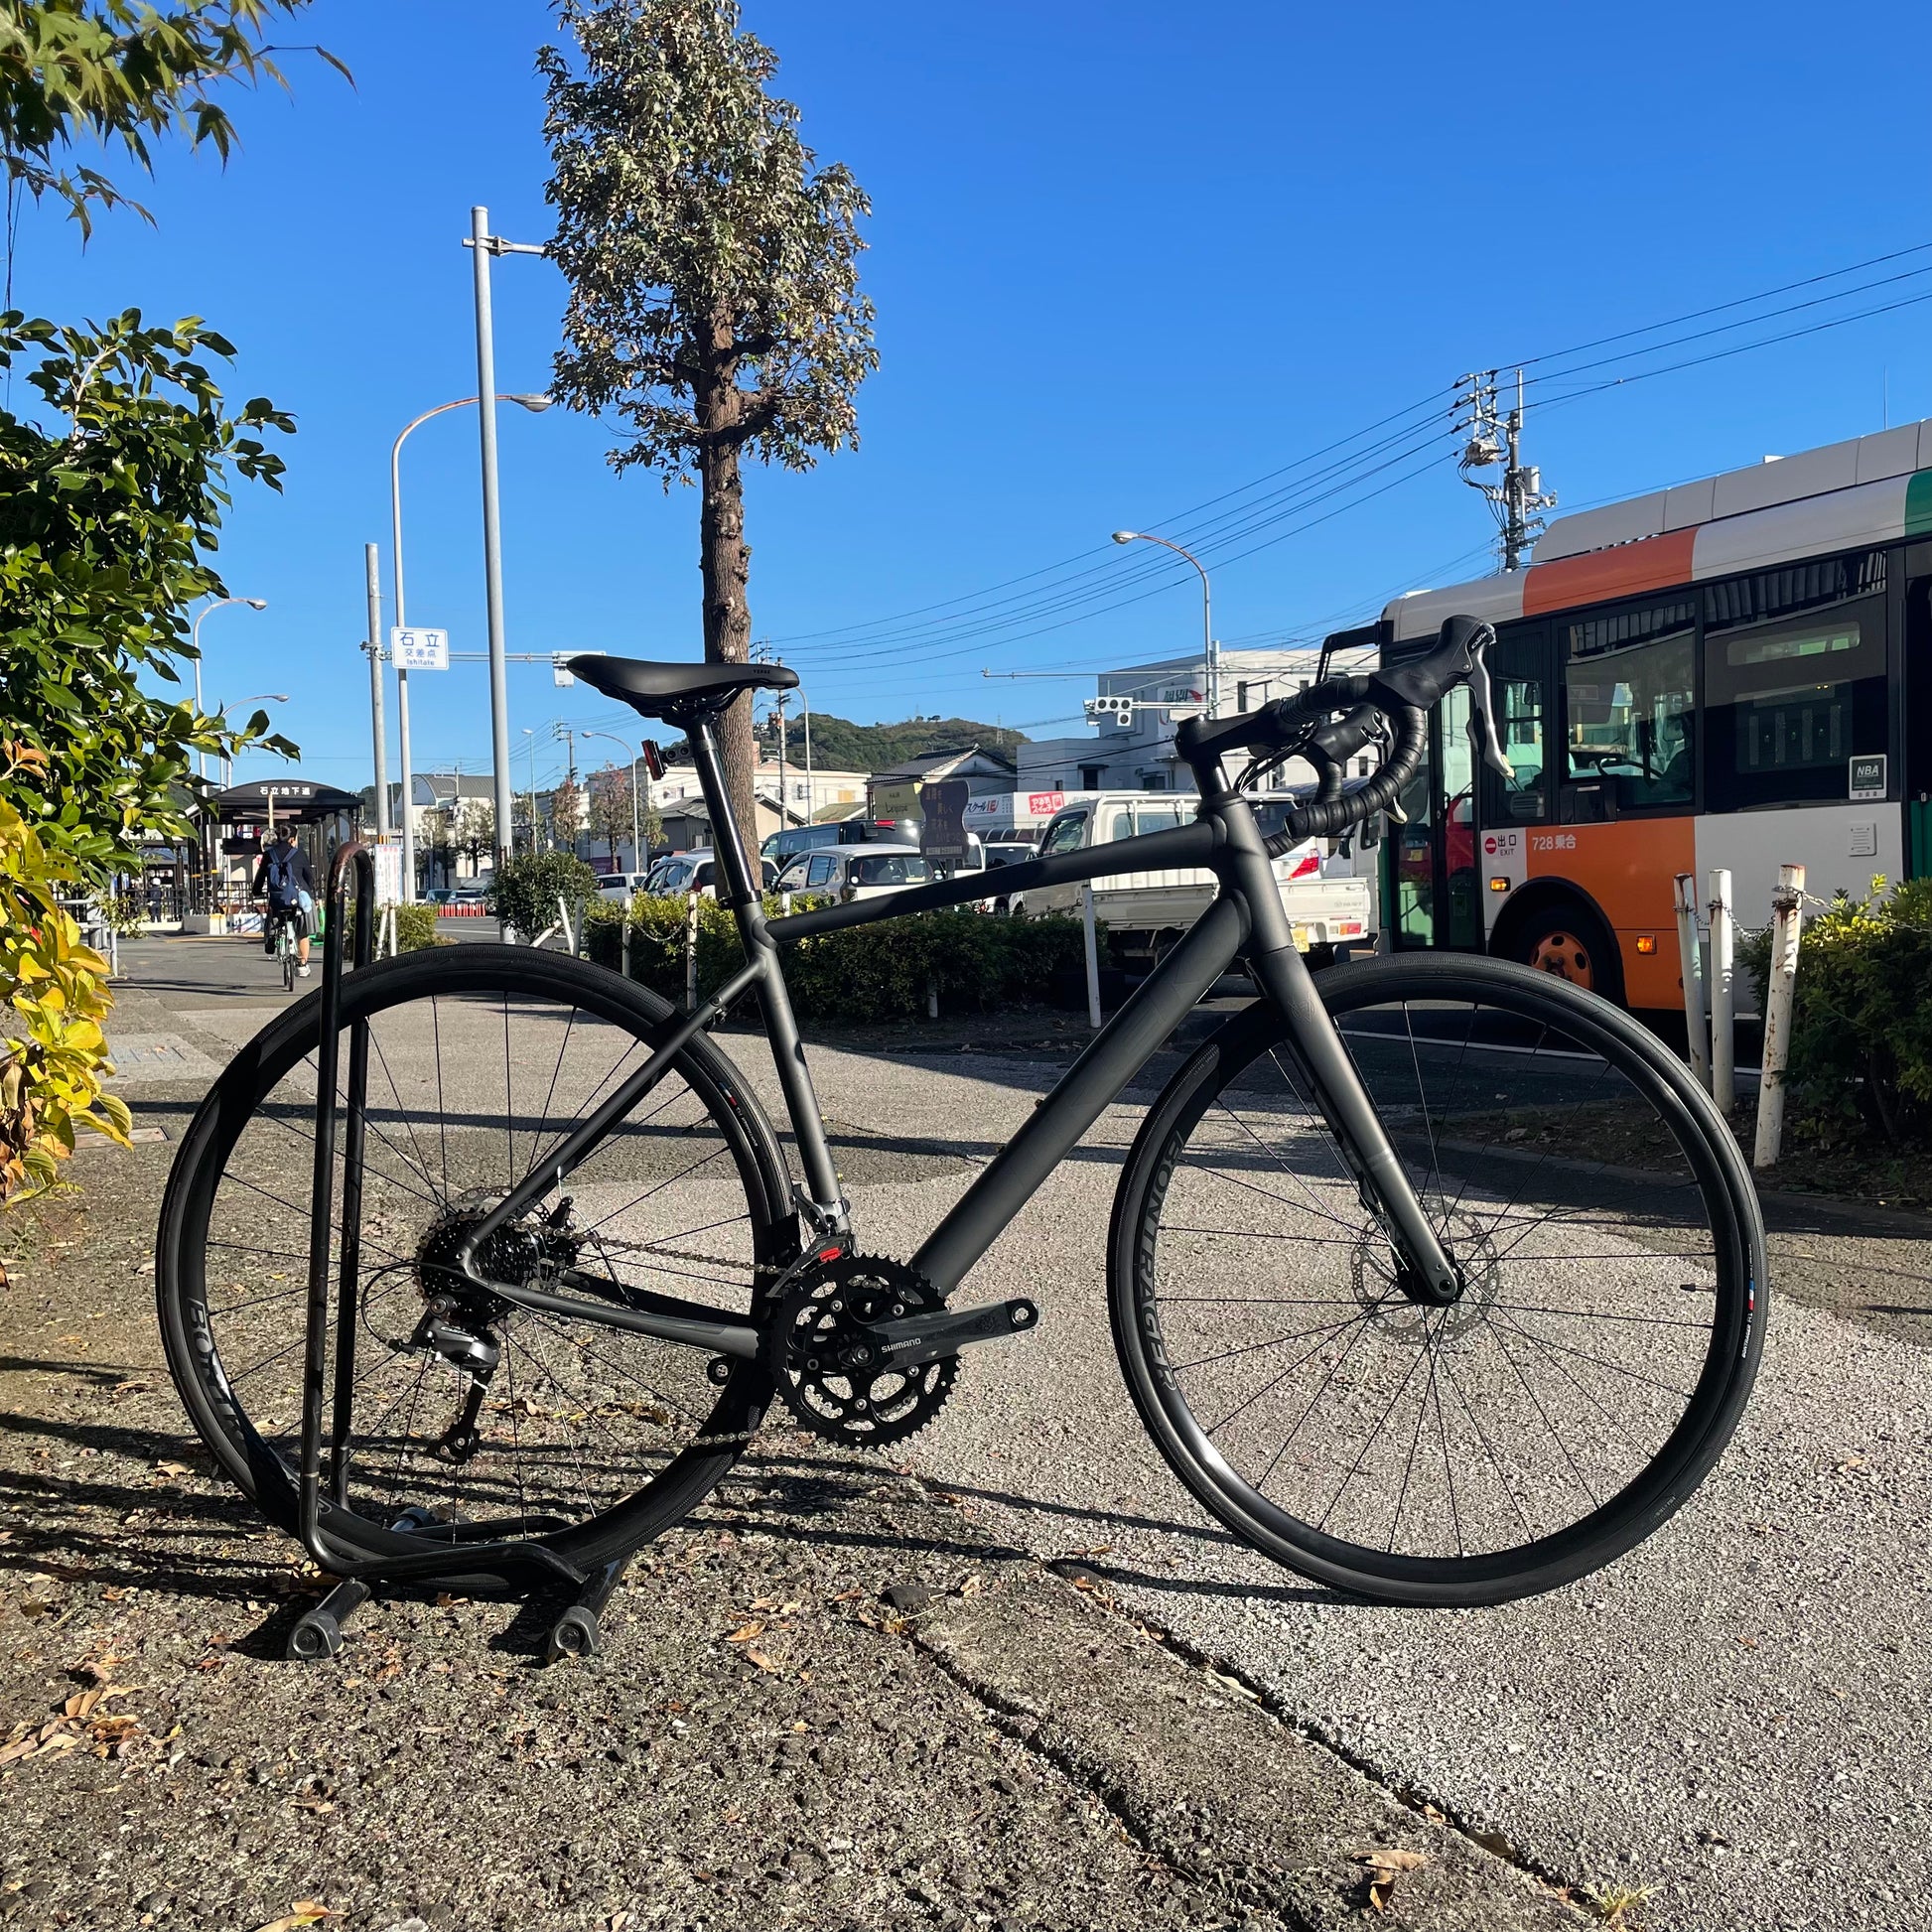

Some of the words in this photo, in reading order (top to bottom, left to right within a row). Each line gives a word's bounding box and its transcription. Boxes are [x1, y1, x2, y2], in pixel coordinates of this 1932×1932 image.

[399, 631, 440, 647] 石立
[404, 648, 437, 658] 交差点
[1857, 764, 1879, 777] NBA
[259, 786, 311, 796] 石立地下道
[1497, 834, 1517, 847] 出口
[1141, 1130, 1184, 1391] BONTRAGER
[881, 1337, 921, 1353] SHIMANO
